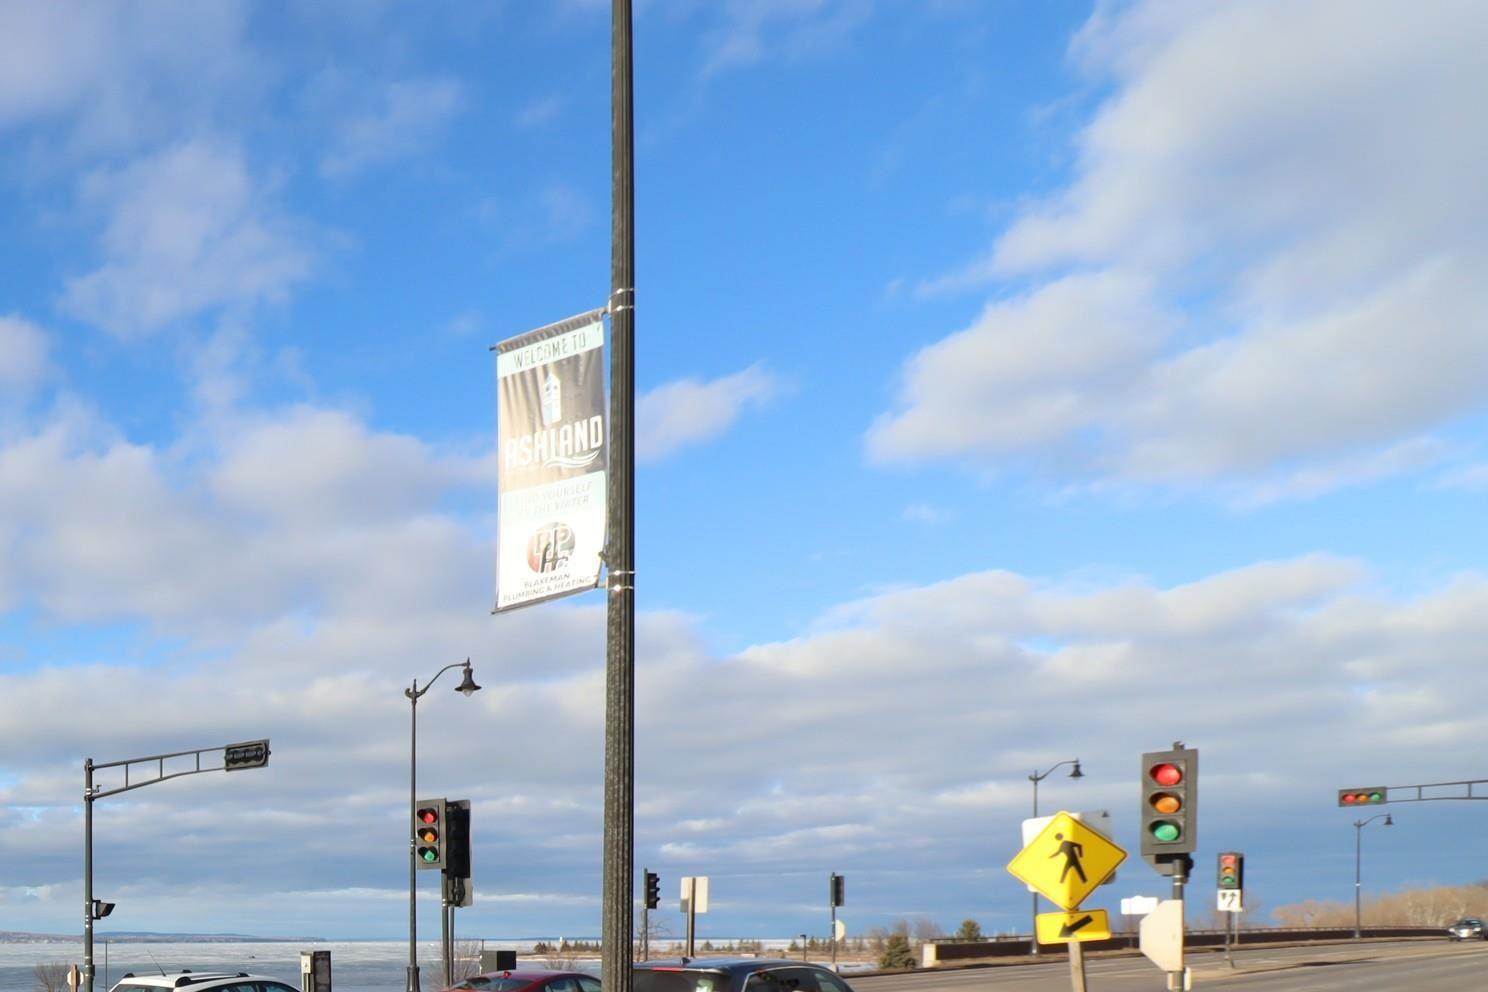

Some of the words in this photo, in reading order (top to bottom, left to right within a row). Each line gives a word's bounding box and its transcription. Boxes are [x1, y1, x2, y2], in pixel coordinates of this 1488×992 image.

[514, 337, 568, 368] WELCOME
[572, 332, 587, 351] TO
[505, 415, 603, 469] ASHLAND
[503, 586, 545, 603] PLUMBING
[554, 576, 592, 591] HEATING
[524, 573, 571, 589] BLAKEMAN
